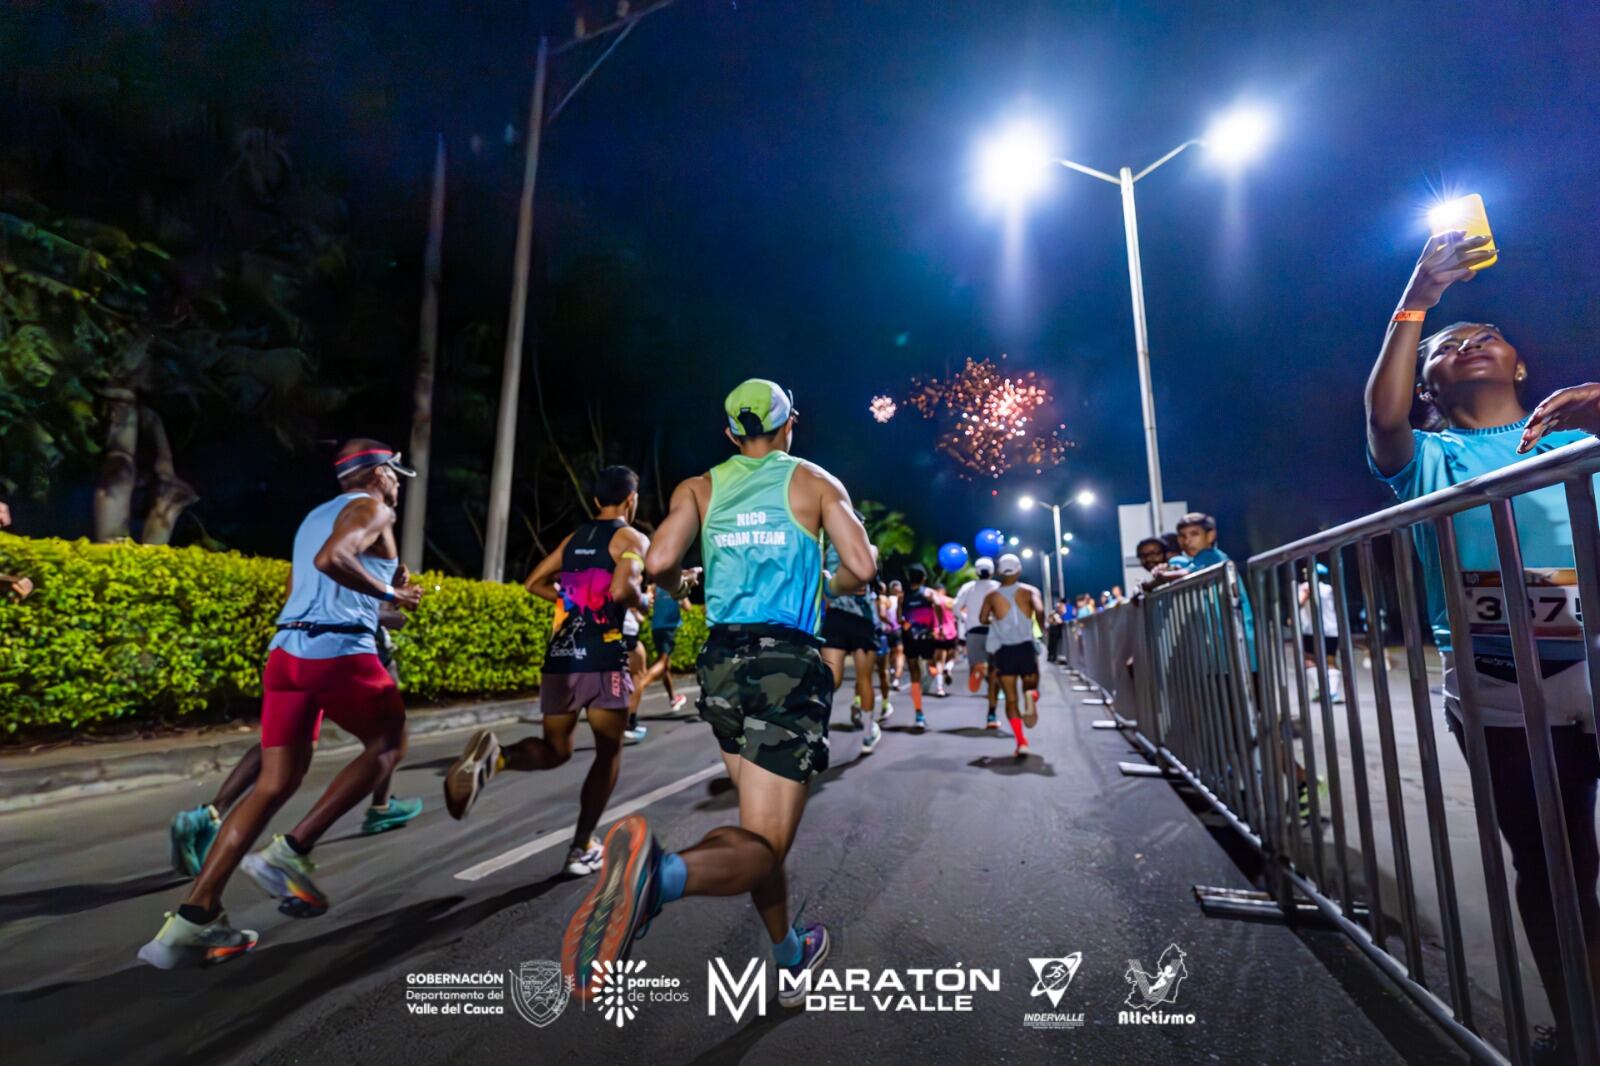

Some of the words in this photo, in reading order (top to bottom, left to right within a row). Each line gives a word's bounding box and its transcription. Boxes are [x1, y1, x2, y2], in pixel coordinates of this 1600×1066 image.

[736, 511, 767, 527] NICO
[713, 531, 750, 548] VEGAN
[752, 530, 786, 545] TEAM
[1476, 595, 1567, 622] 37
